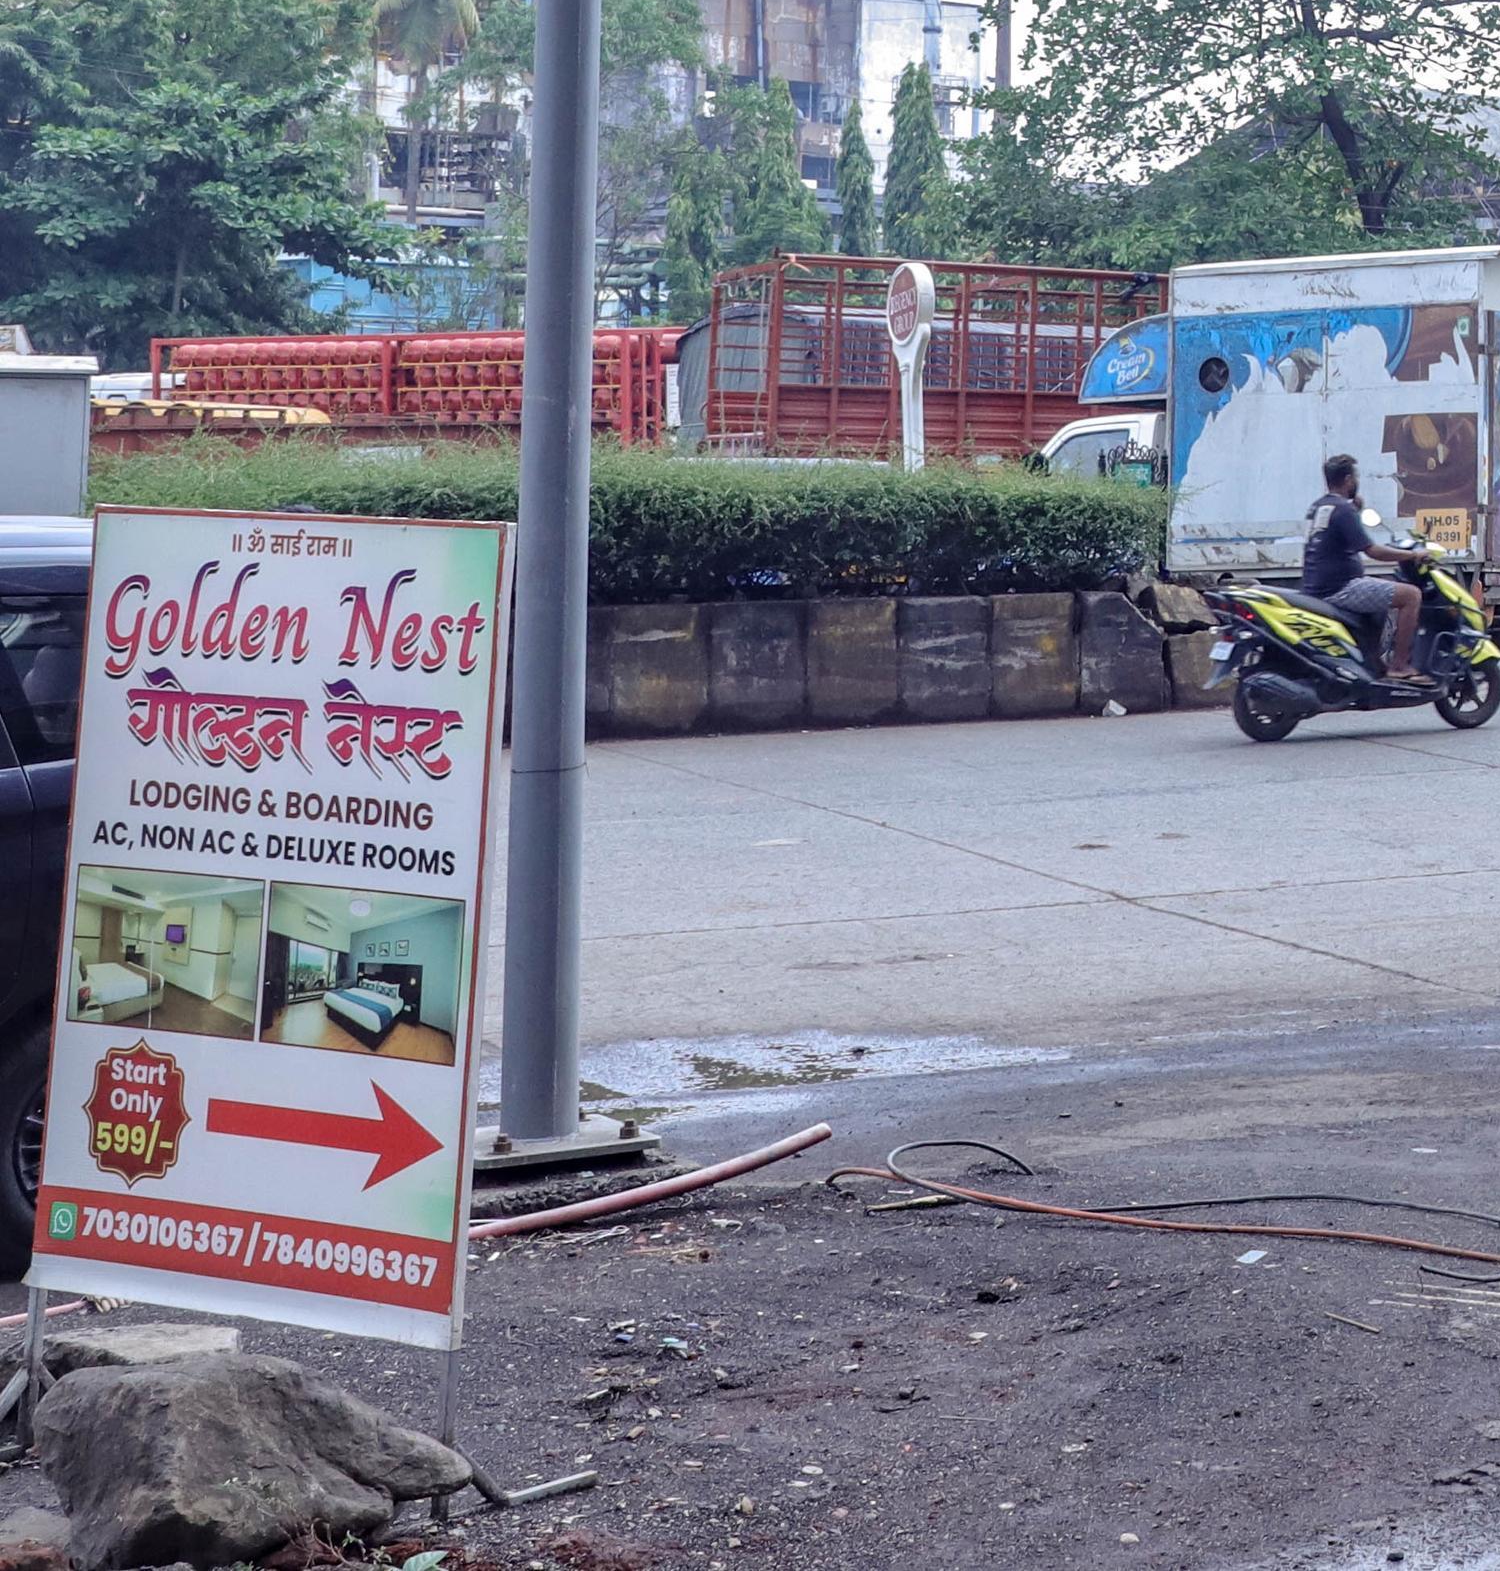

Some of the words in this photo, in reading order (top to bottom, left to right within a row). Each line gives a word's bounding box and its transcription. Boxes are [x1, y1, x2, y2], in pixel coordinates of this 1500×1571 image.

[271, 529, 305, 557] साई
[307, 536, 338, 556] राम
[104, 559, 310, 677] Golden
[340, 567, 486, 676] Nest
[126, 666, 313, 775] गोल्डन
[322, 678, 464, 784] नेस्ट
[129, 779, 251, 815] LODGING
[257, 789, 277, 818] &
[285, 792, 434, 831] BOARDING
[92, 820, 133, 851] AC,
[141, 824, 194, 852] NON
[200, 829, 235, 855] AC
[241, 833, 260, 858] &
[266, 835, 355, 866] DELUXE
[362, 843, 456, 876] ROOMS
[111, 1058, 167, 1087] Start
[110, 1088, 164, 1122] Only
[96, 1120, 174, 1164] 599/-
